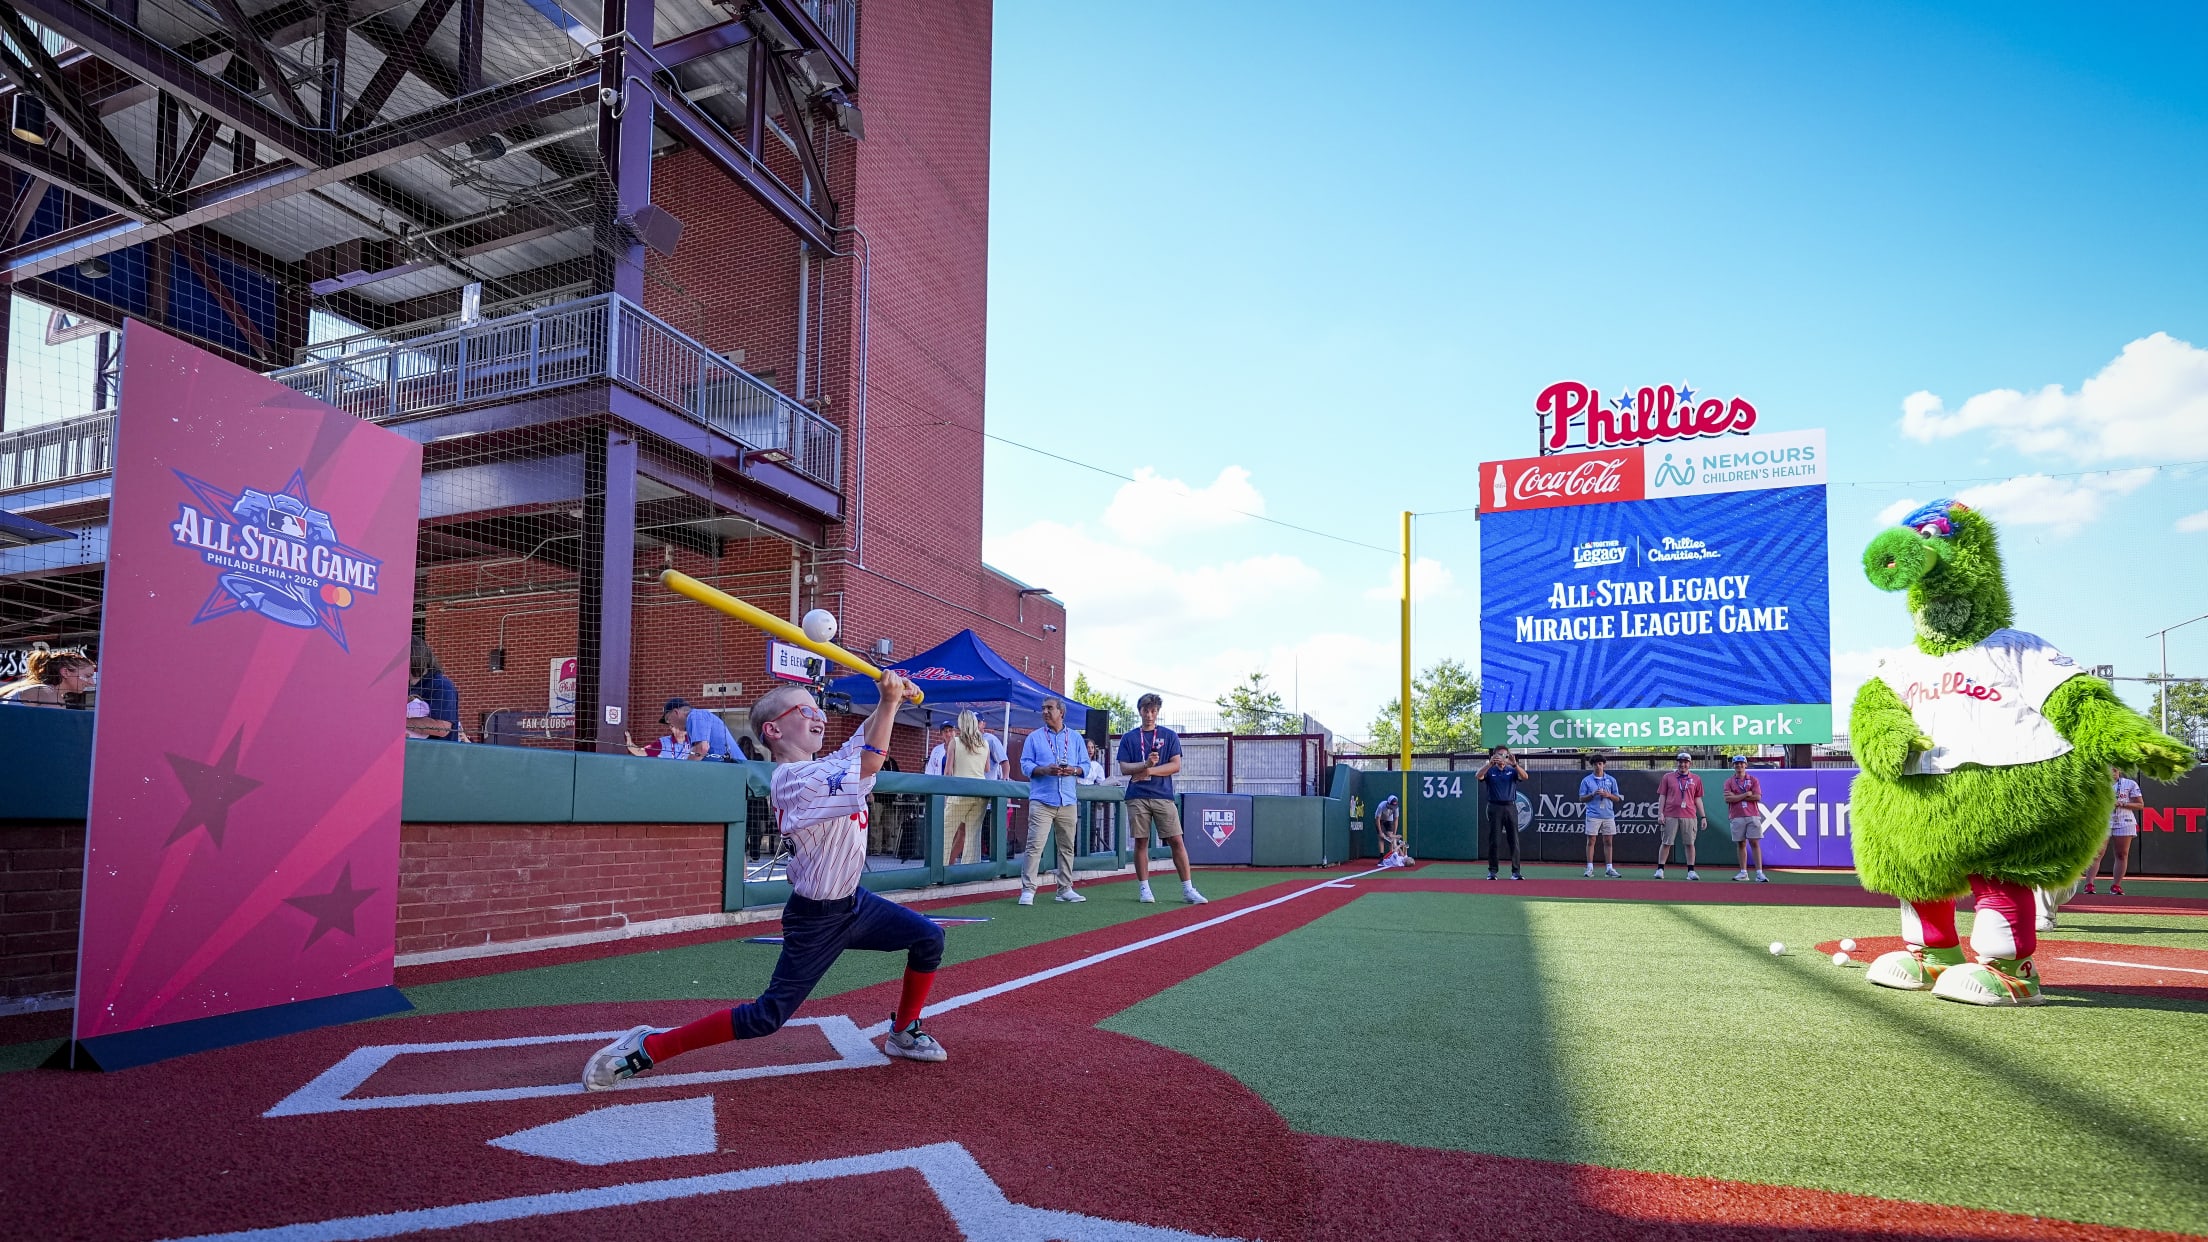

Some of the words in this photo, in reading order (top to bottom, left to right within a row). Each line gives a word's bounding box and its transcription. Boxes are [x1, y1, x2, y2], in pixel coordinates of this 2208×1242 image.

[1536, 380, 1757, 449] Phillies
[1702, 446, 1816, 470] NEMOURS
[1513, 457, 1627, 500] Coca-Cola
[1702, 469, 1769, 484] CHILDREN'S
[1772, 464, 1816, 479] HEALTH
[173, 506, 235, 554] ALL
[239, 524, 308, 574] STAR
[311, 545, 378, 591] GAME
[1573, 546, 1628, 567] Legacy
[1662, 537, 1705, 551] Phillies
[206, 552, 287, 580] PHILADELPHIA
[294, 574, 319, 588] 2026
[1548, 582, 1594, 609] ALL
[1596, 579, 1655, 607] STAR
[1658, 574, 1750, 603] LEGACY
[1515, 615, 1615, 643] MIRACLE
[1620, 610, 1713, 639] LEAGUE
[1718, 605, 1789, 634] GAME
[1907, 671, 2003, 710] Phillies
[522, 719, 537, 729] FAN
[541, 719, 566, 729] CLUBS
[1549, 717, 1651, 739] Citizens
[1658, 715, 1725, 737] Bank
[1422, 776, 1463, 799] 334
[1204, 811, 1234, 822] MLB
[1758, 788, 1850, 850] xfin
[2136, 807, 2206, 833] NT
